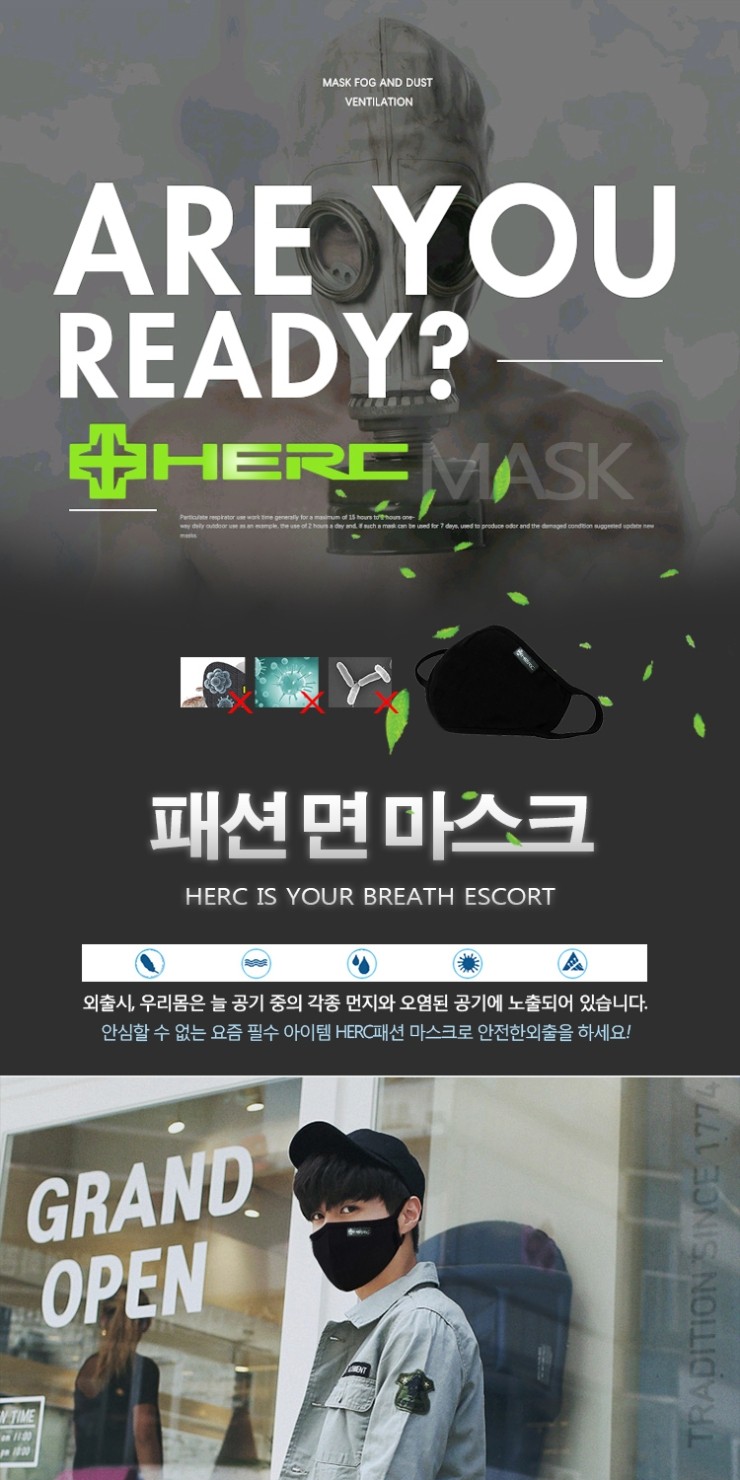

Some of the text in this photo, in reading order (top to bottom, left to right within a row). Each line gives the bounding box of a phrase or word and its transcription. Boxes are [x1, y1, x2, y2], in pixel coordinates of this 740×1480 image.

[27, 1145, 254, 1243] GRAND
[692, 1165, 719, 1263] SINCE
[41, 1241, 208, 1328] OPEN
[687, 1271, 718, 1449] TRADITION
[11, 1409, 36, 1424] TIME
